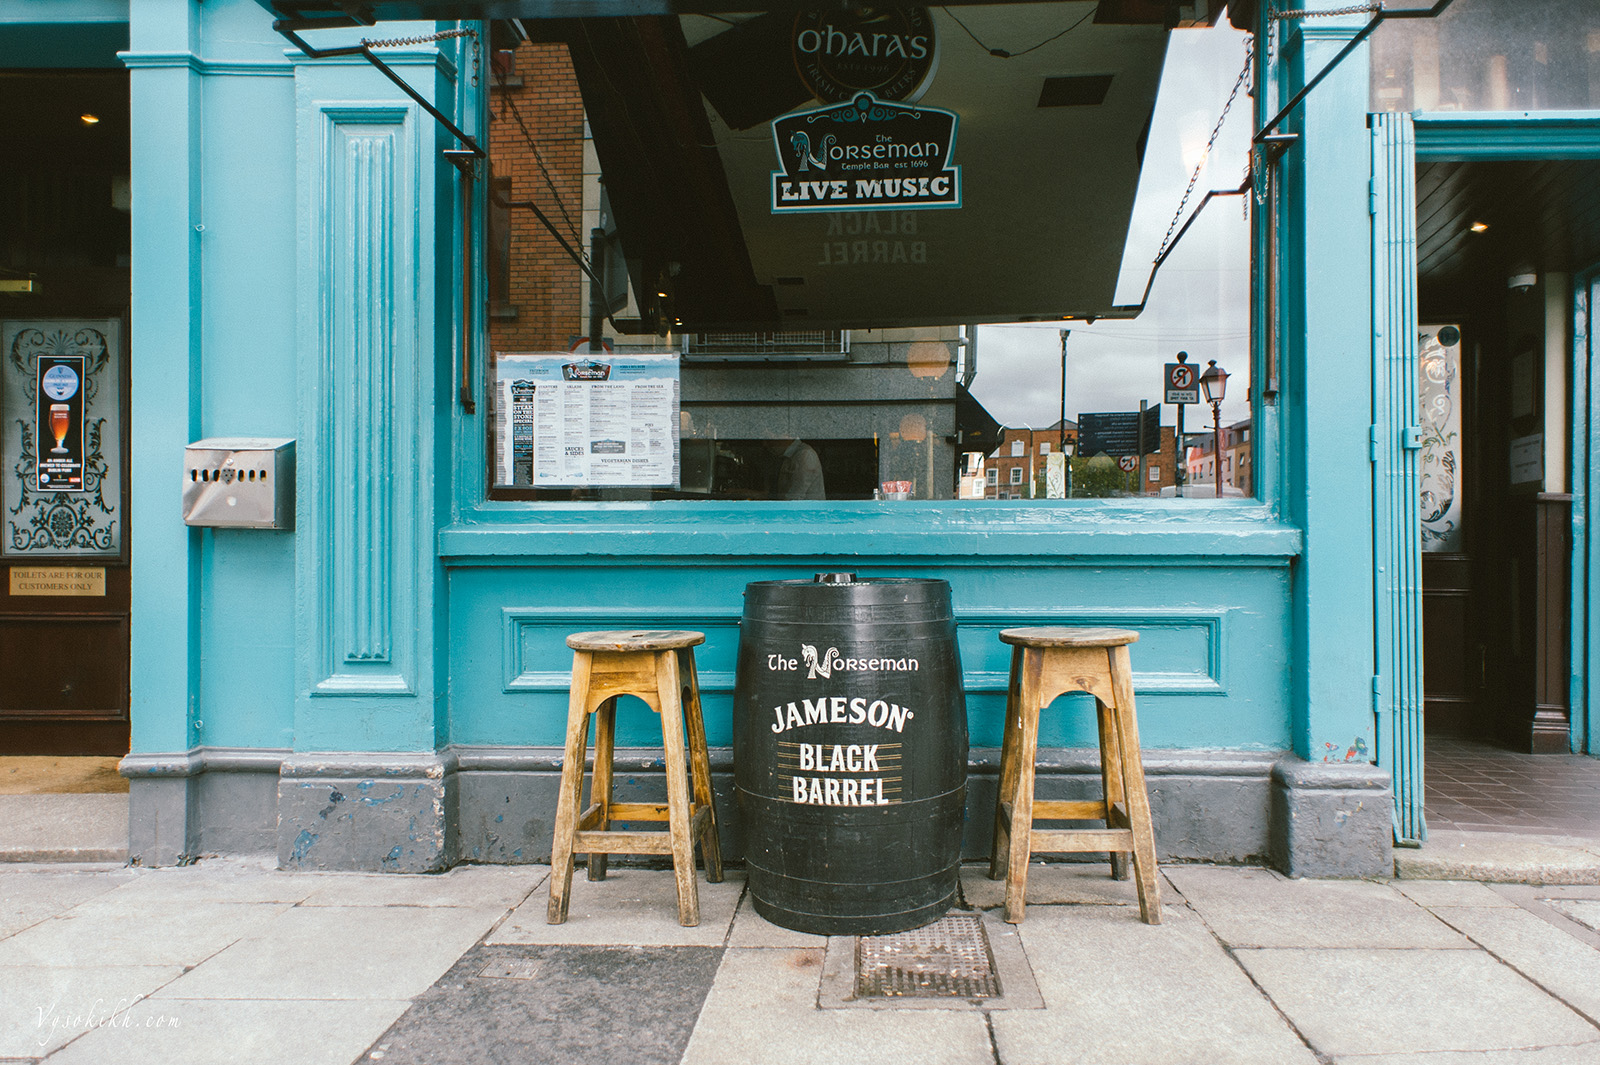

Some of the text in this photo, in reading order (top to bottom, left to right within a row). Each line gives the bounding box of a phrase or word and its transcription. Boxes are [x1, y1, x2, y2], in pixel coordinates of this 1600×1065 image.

[875, 134, 893, 143] The
[841, 161, 871, 171] Temple
[910, 160, 929, 168] 1696
[781, 176, 950, 201] LIVE MUSIC
[13, 571, 102, 579] TOILETS ARE FOR OUR
[768, 643, 919, 679] The Norseman
[771, 697, 910, 734] JAMESON
[800, 743, 879, 772] BLACK
[792, 776, 889, 807] BARREL
